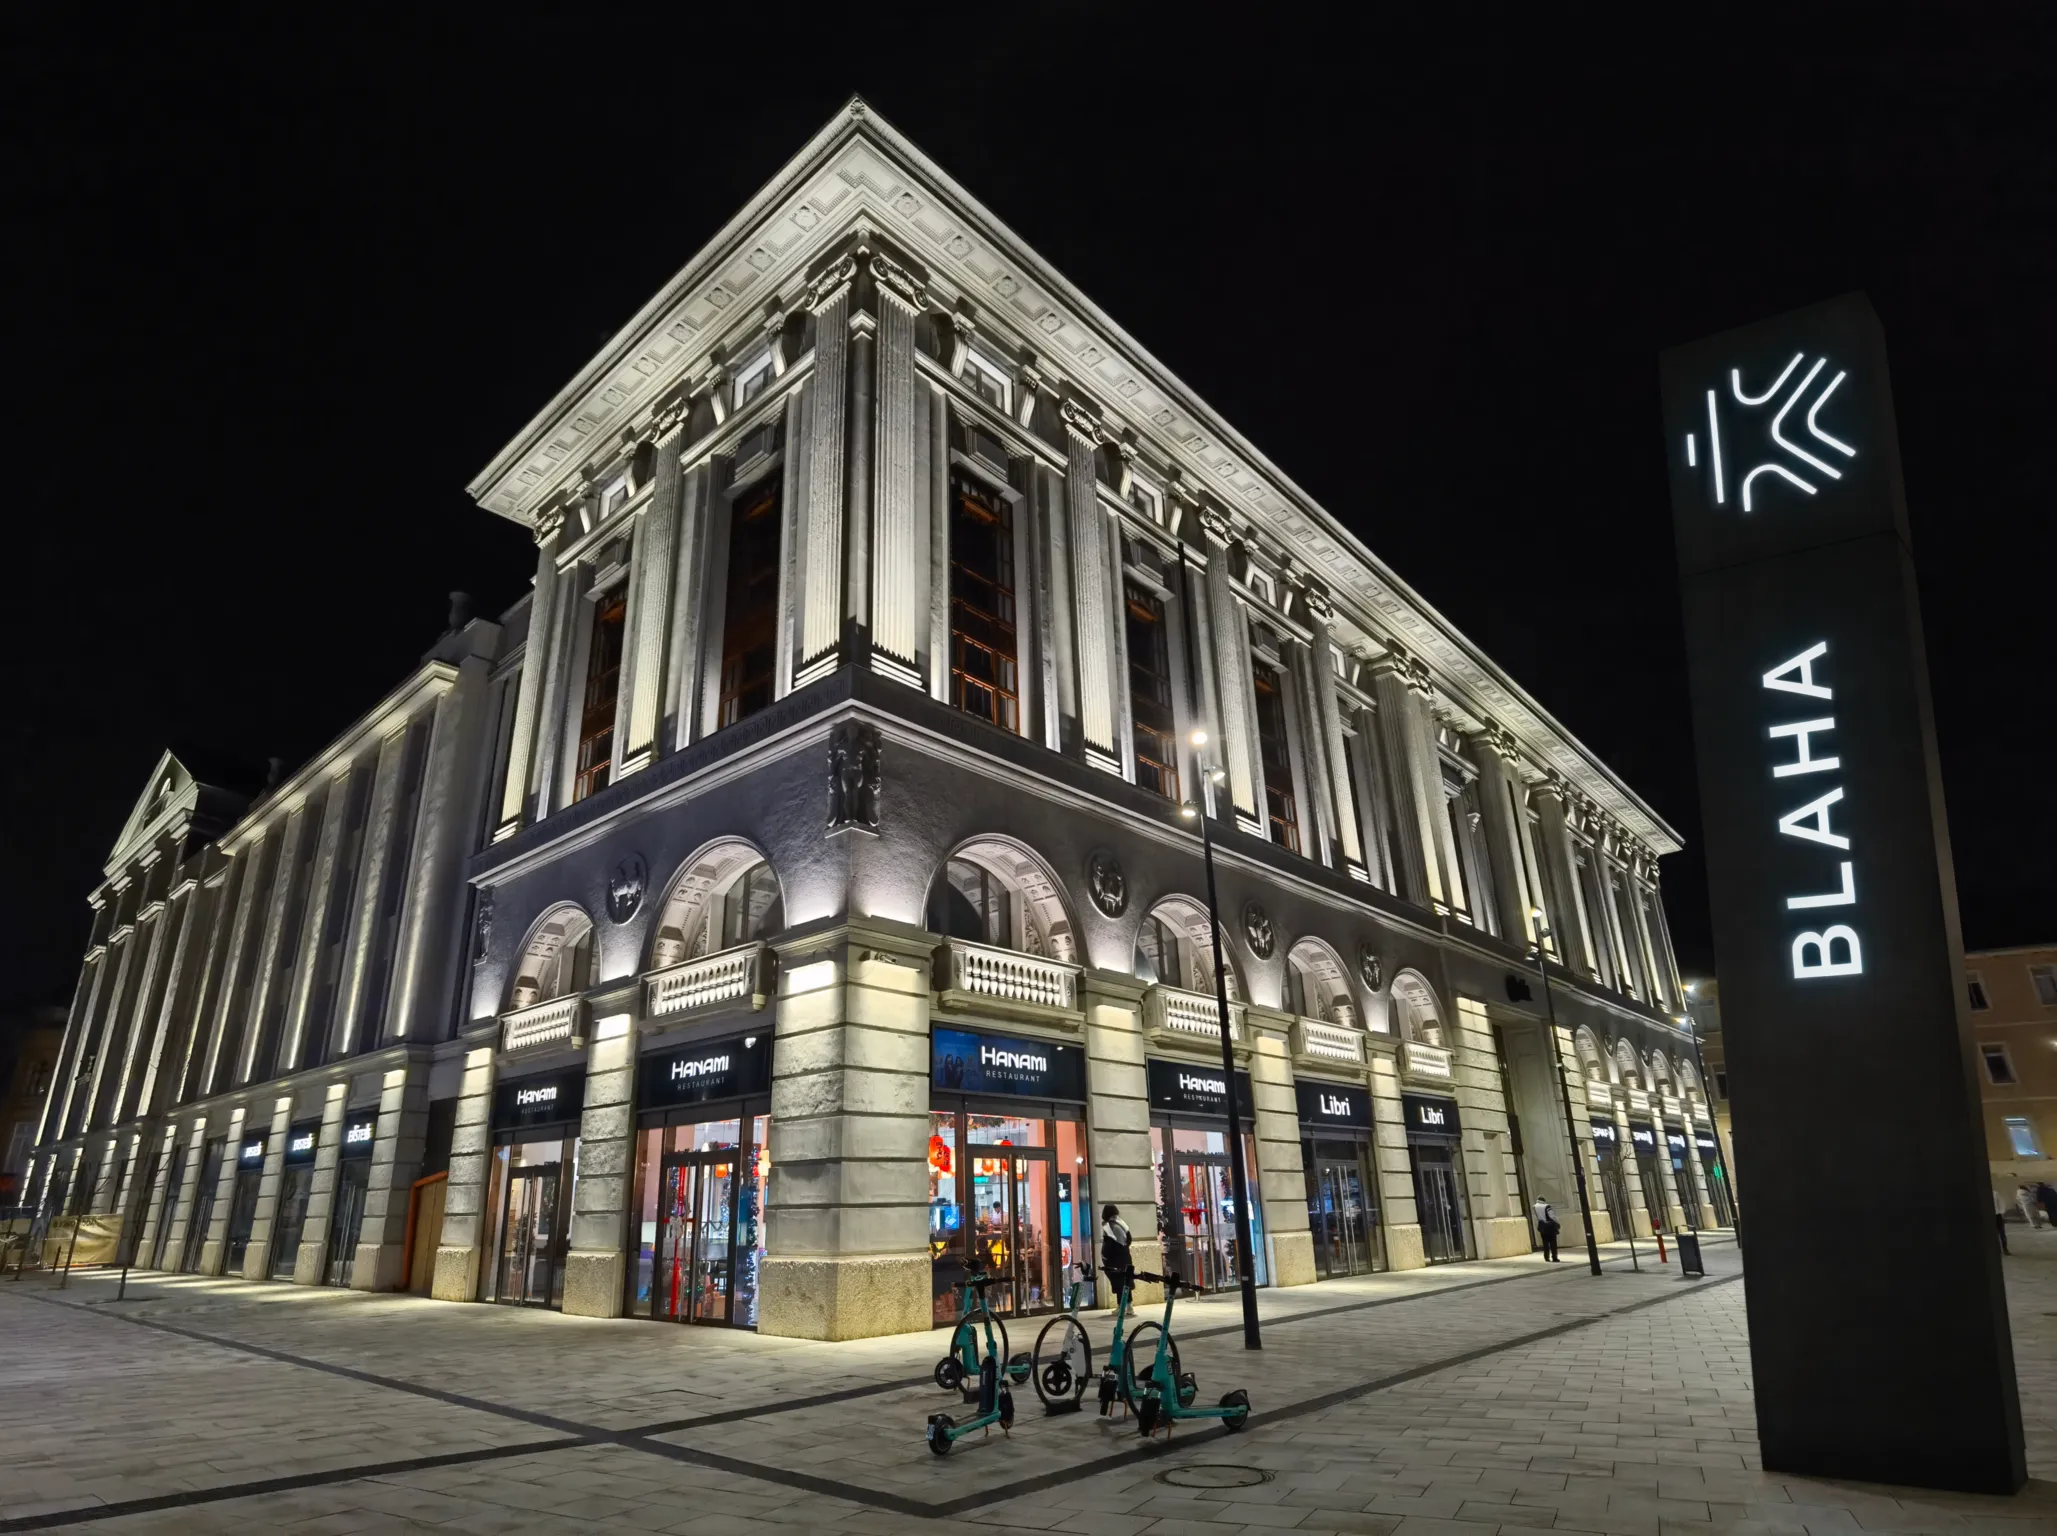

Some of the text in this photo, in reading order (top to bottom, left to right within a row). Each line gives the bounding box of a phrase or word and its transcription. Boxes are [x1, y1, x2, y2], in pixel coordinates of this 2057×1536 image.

[1762, 641, 1863, 979] BLAHA
[677, 1076, 726, 1092] RESTAURANT
[984, 1070, 1041, 1083] RESTAURANT
[1319, 1094, 1350, 1115] Libri
[1420, 1104, 1445, 1125] Libri
